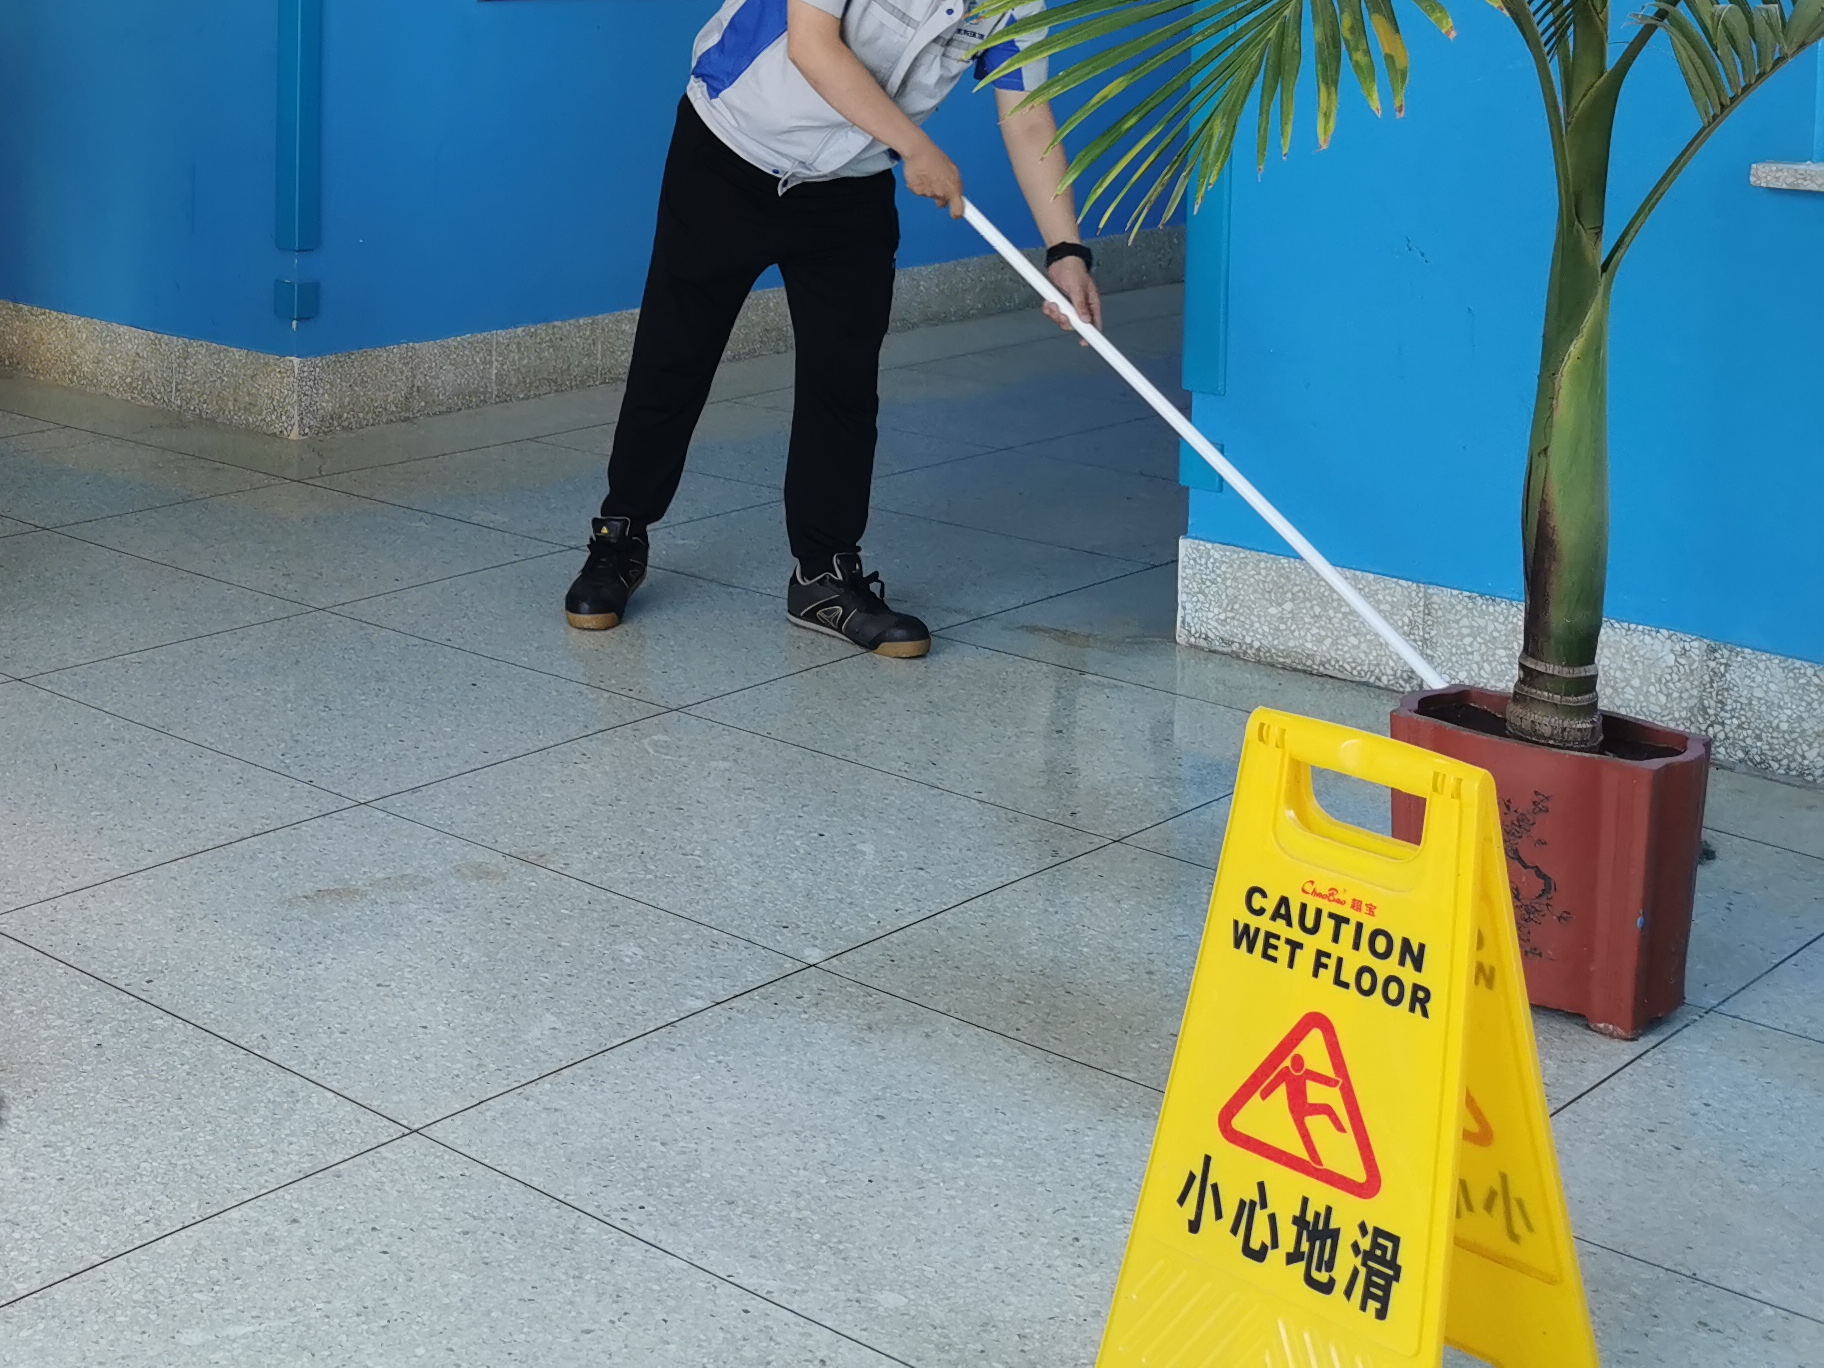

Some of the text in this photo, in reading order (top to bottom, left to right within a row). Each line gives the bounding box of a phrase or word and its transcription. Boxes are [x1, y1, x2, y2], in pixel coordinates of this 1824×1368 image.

[1232, 920, 1432, 1019] WET FLOOR
[1245, 885, 1427, 973] CAUTION
[1176, 1153, 1403, 1322] 小心地滑
